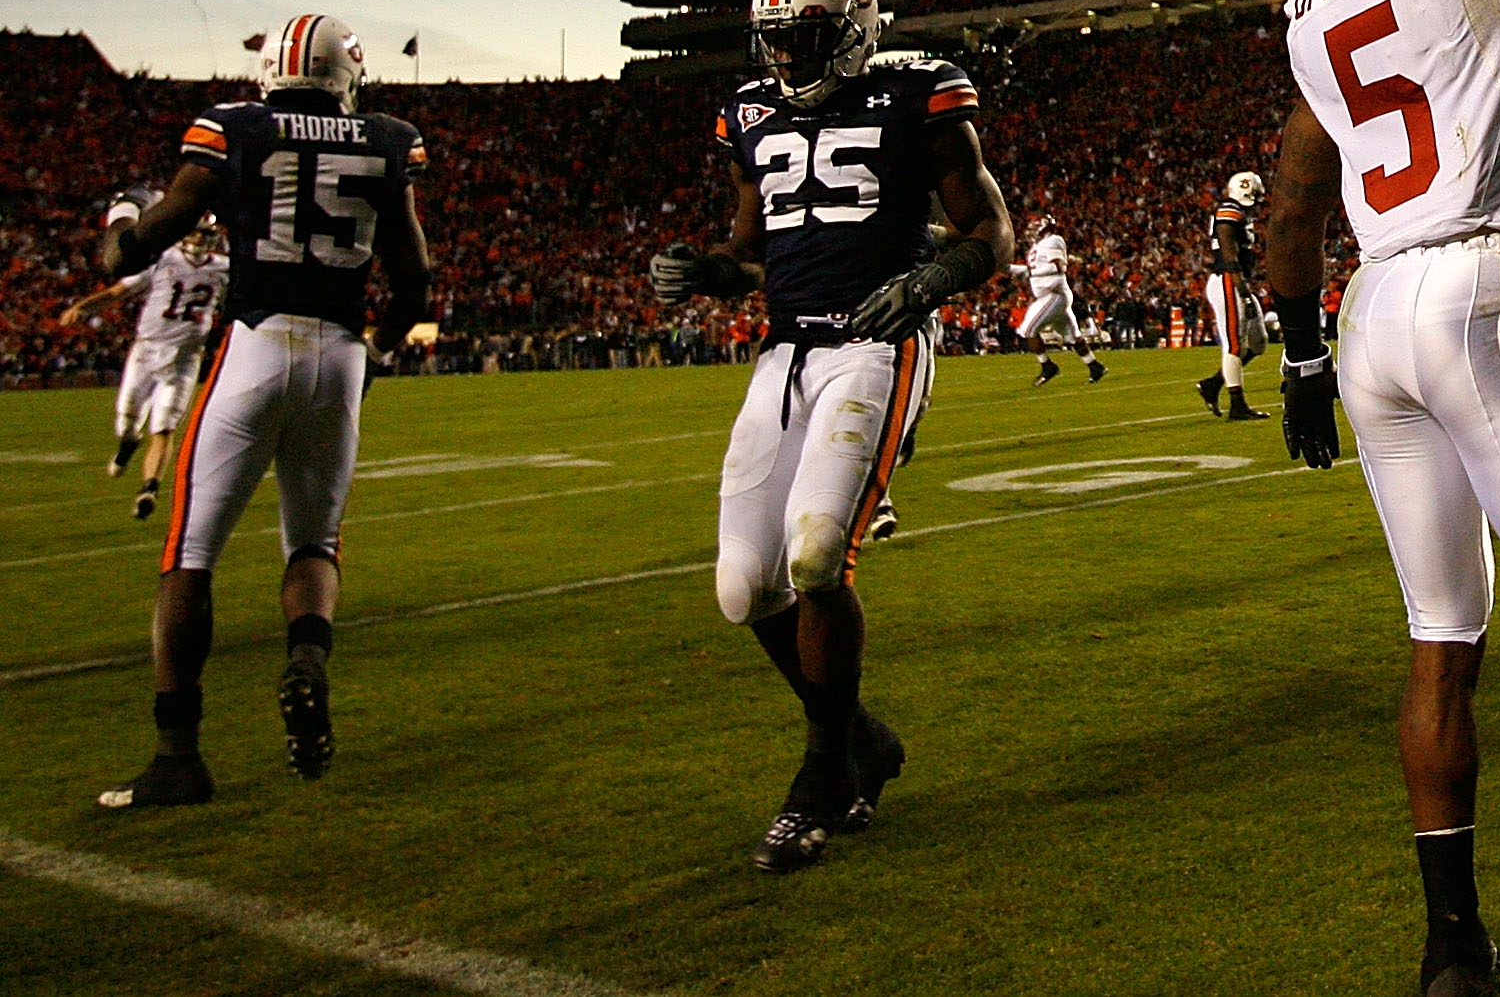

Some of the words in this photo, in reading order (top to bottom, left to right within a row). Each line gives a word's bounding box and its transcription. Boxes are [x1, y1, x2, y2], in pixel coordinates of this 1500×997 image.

[272, 112, 368, 143] THORPE
[256, 150, 388, 269] 15
[755, 127, 882, 231] 25
[162, 280, 214, 323] 12
